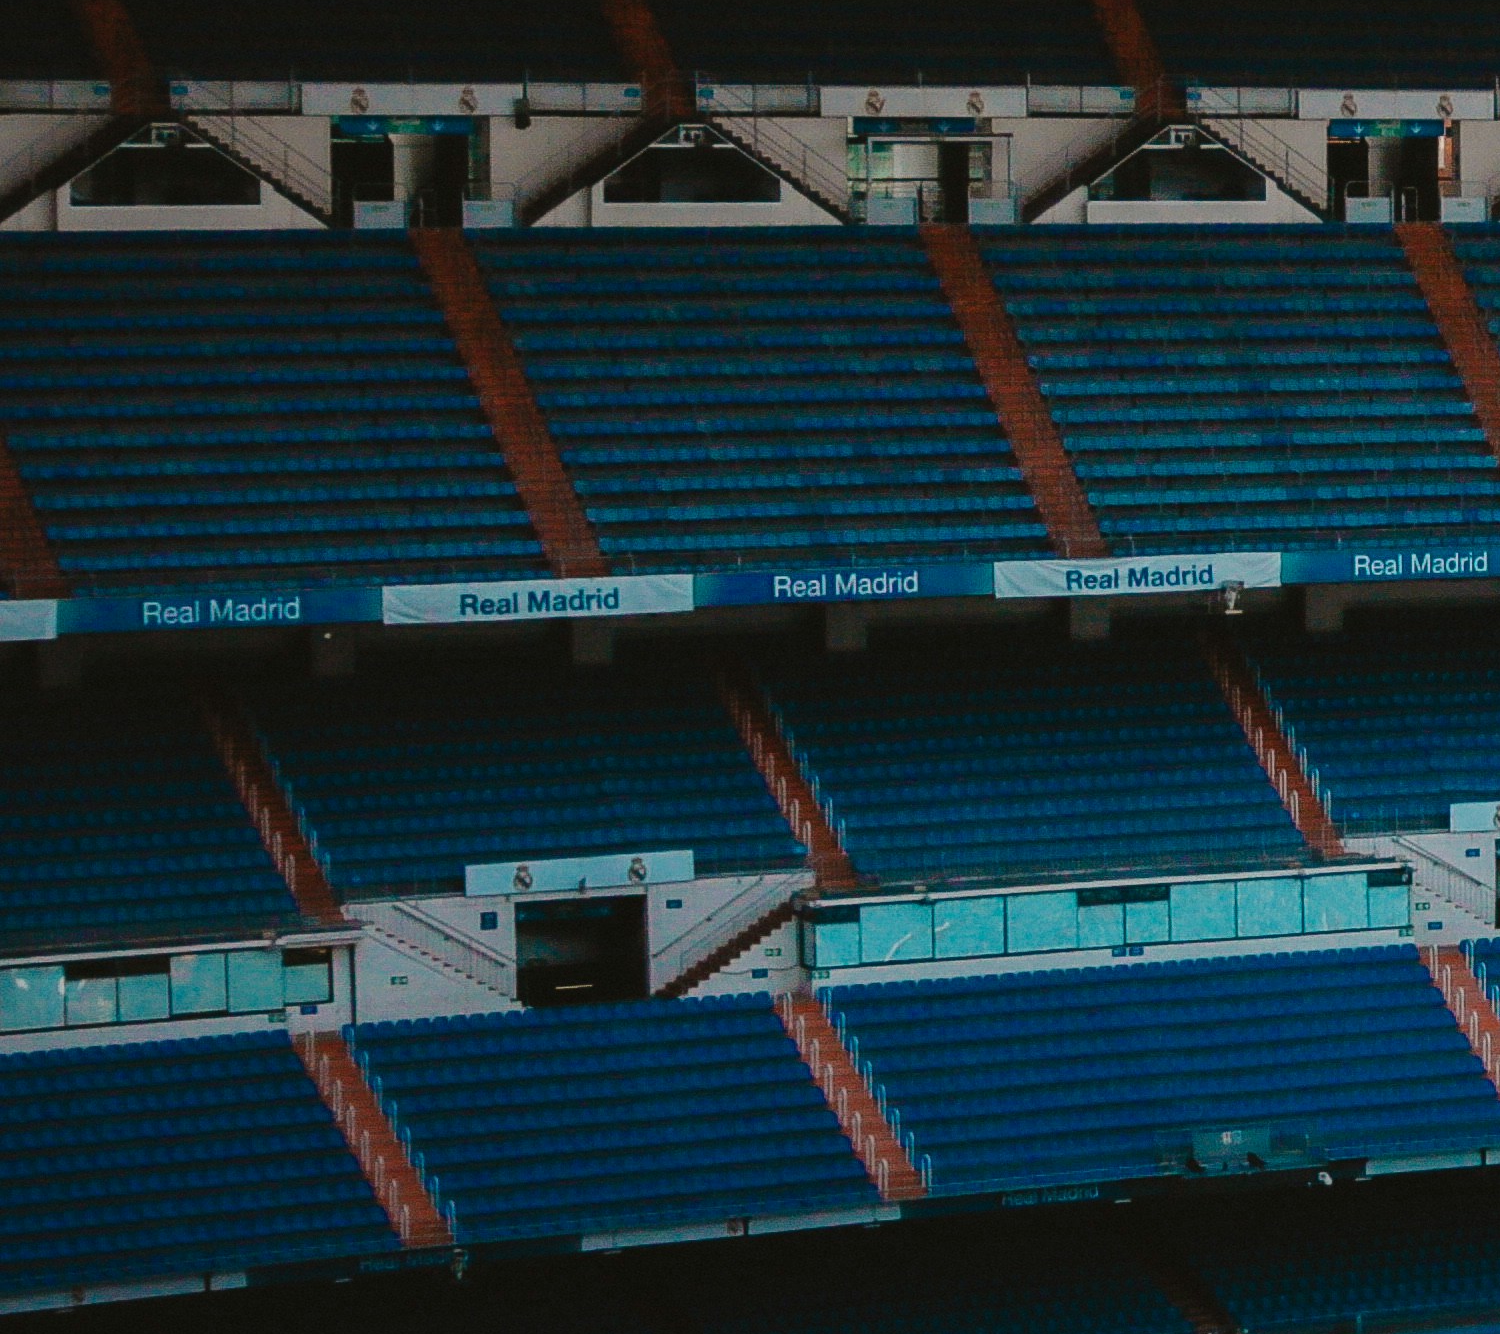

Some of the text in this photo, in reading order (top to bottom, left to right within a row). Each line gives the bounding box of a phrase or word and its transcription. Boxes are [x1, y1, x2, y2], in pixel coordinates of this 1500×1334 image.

[1354, 551, 1487, 575] Real Madrid
[773, 571, 918, 598] Real Madrid
[1065, 565, 1212, 590] Real Madrid
[143, 596, 300, 625] Real Madrid
[459, 587, 619, 615] Real Madrid
